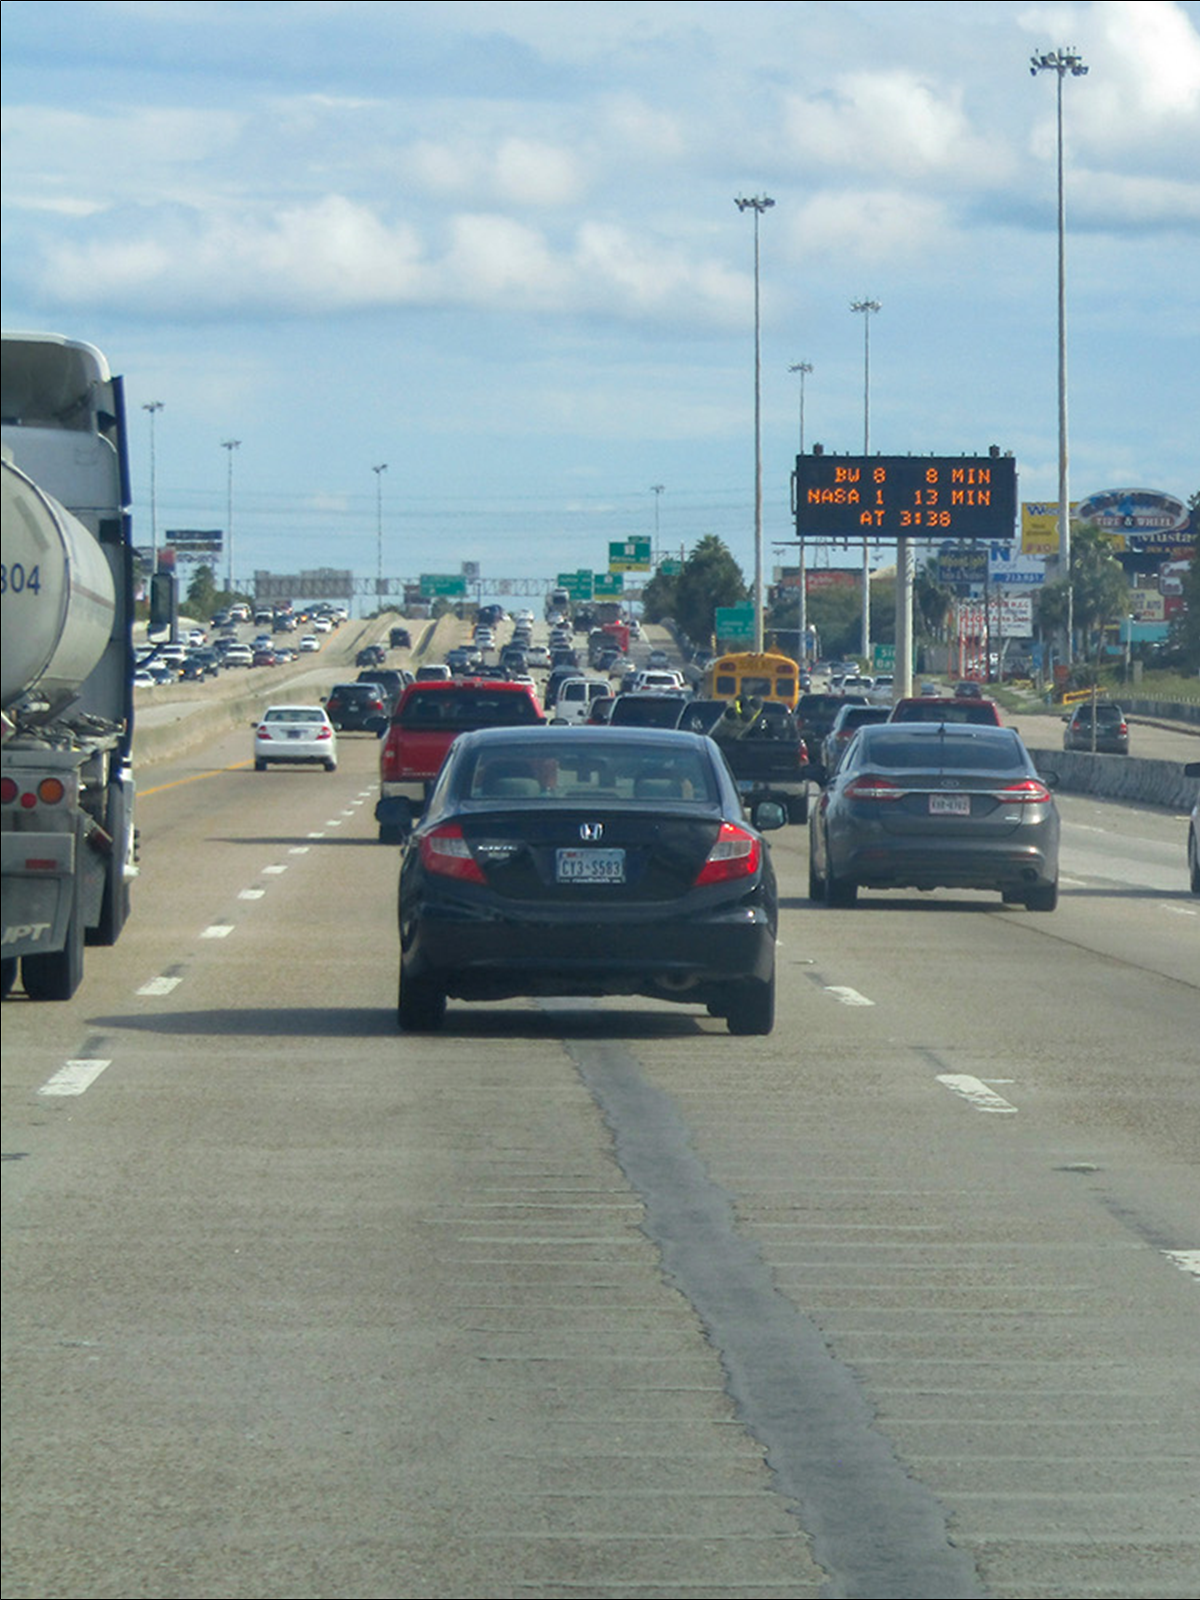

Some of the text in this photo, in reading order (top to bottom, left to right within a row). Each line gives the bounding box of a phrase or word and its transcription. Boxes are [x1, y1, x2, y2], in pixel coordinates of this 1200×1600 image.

[834, 467, 991, 484] BW 8 8 MIN
[807, 488, 991, 506] NASA 1 13 MIN
[860, 510, 951, 527] AT 3:38
[1124, 516, 1134, 526] &
[1136, 517, 1172, 527] WHEEL
